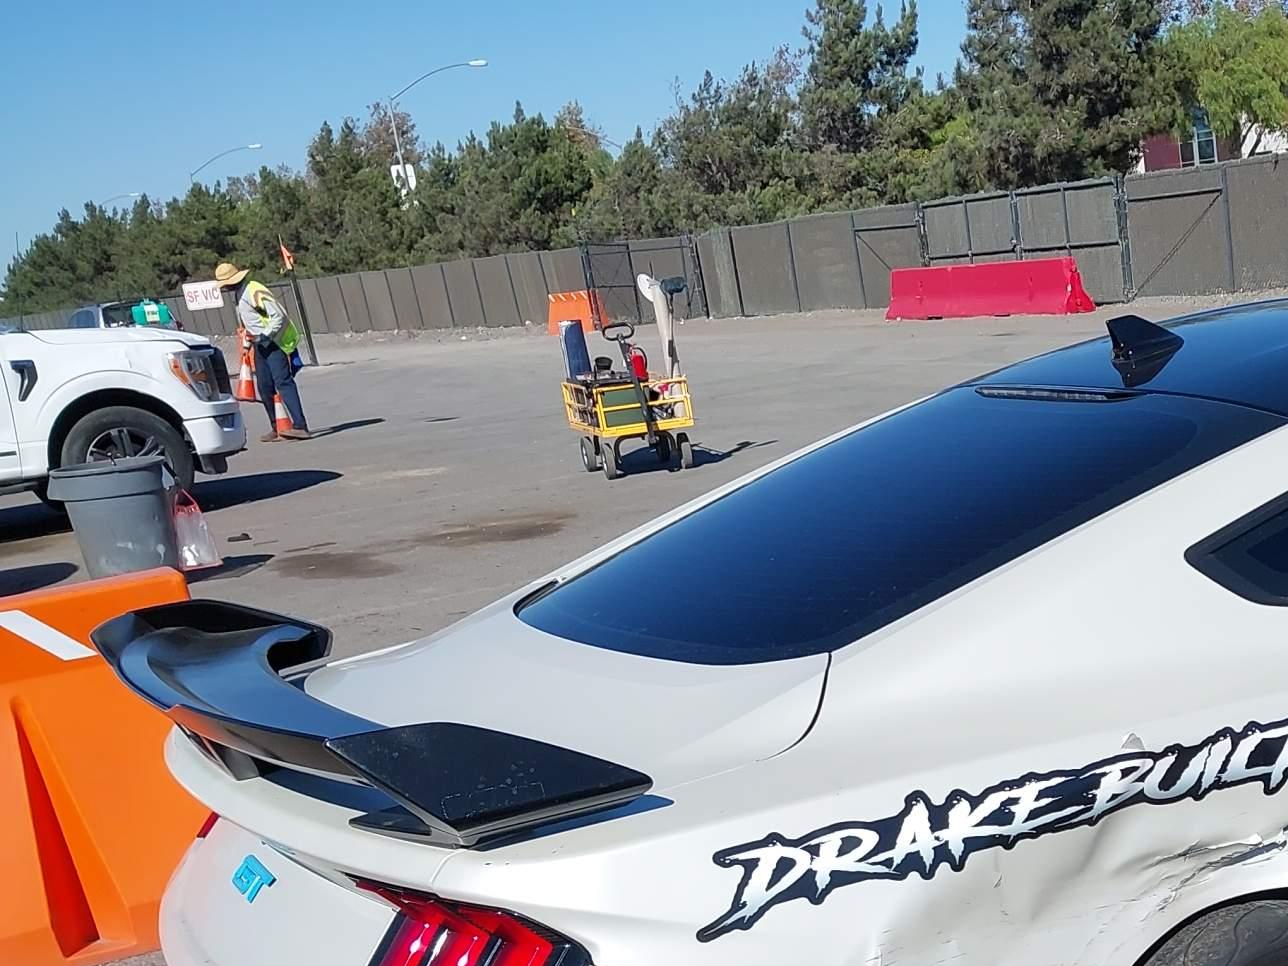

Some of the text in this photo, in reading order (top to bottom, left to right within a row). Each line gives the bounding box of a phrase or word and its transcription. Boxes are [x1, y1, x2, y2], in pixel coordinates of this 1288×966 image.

[186, 287, 220, 303] SF VIC
[232, 854, 276, 904] GT
[699, 776, 1084, 938] DRAKE
